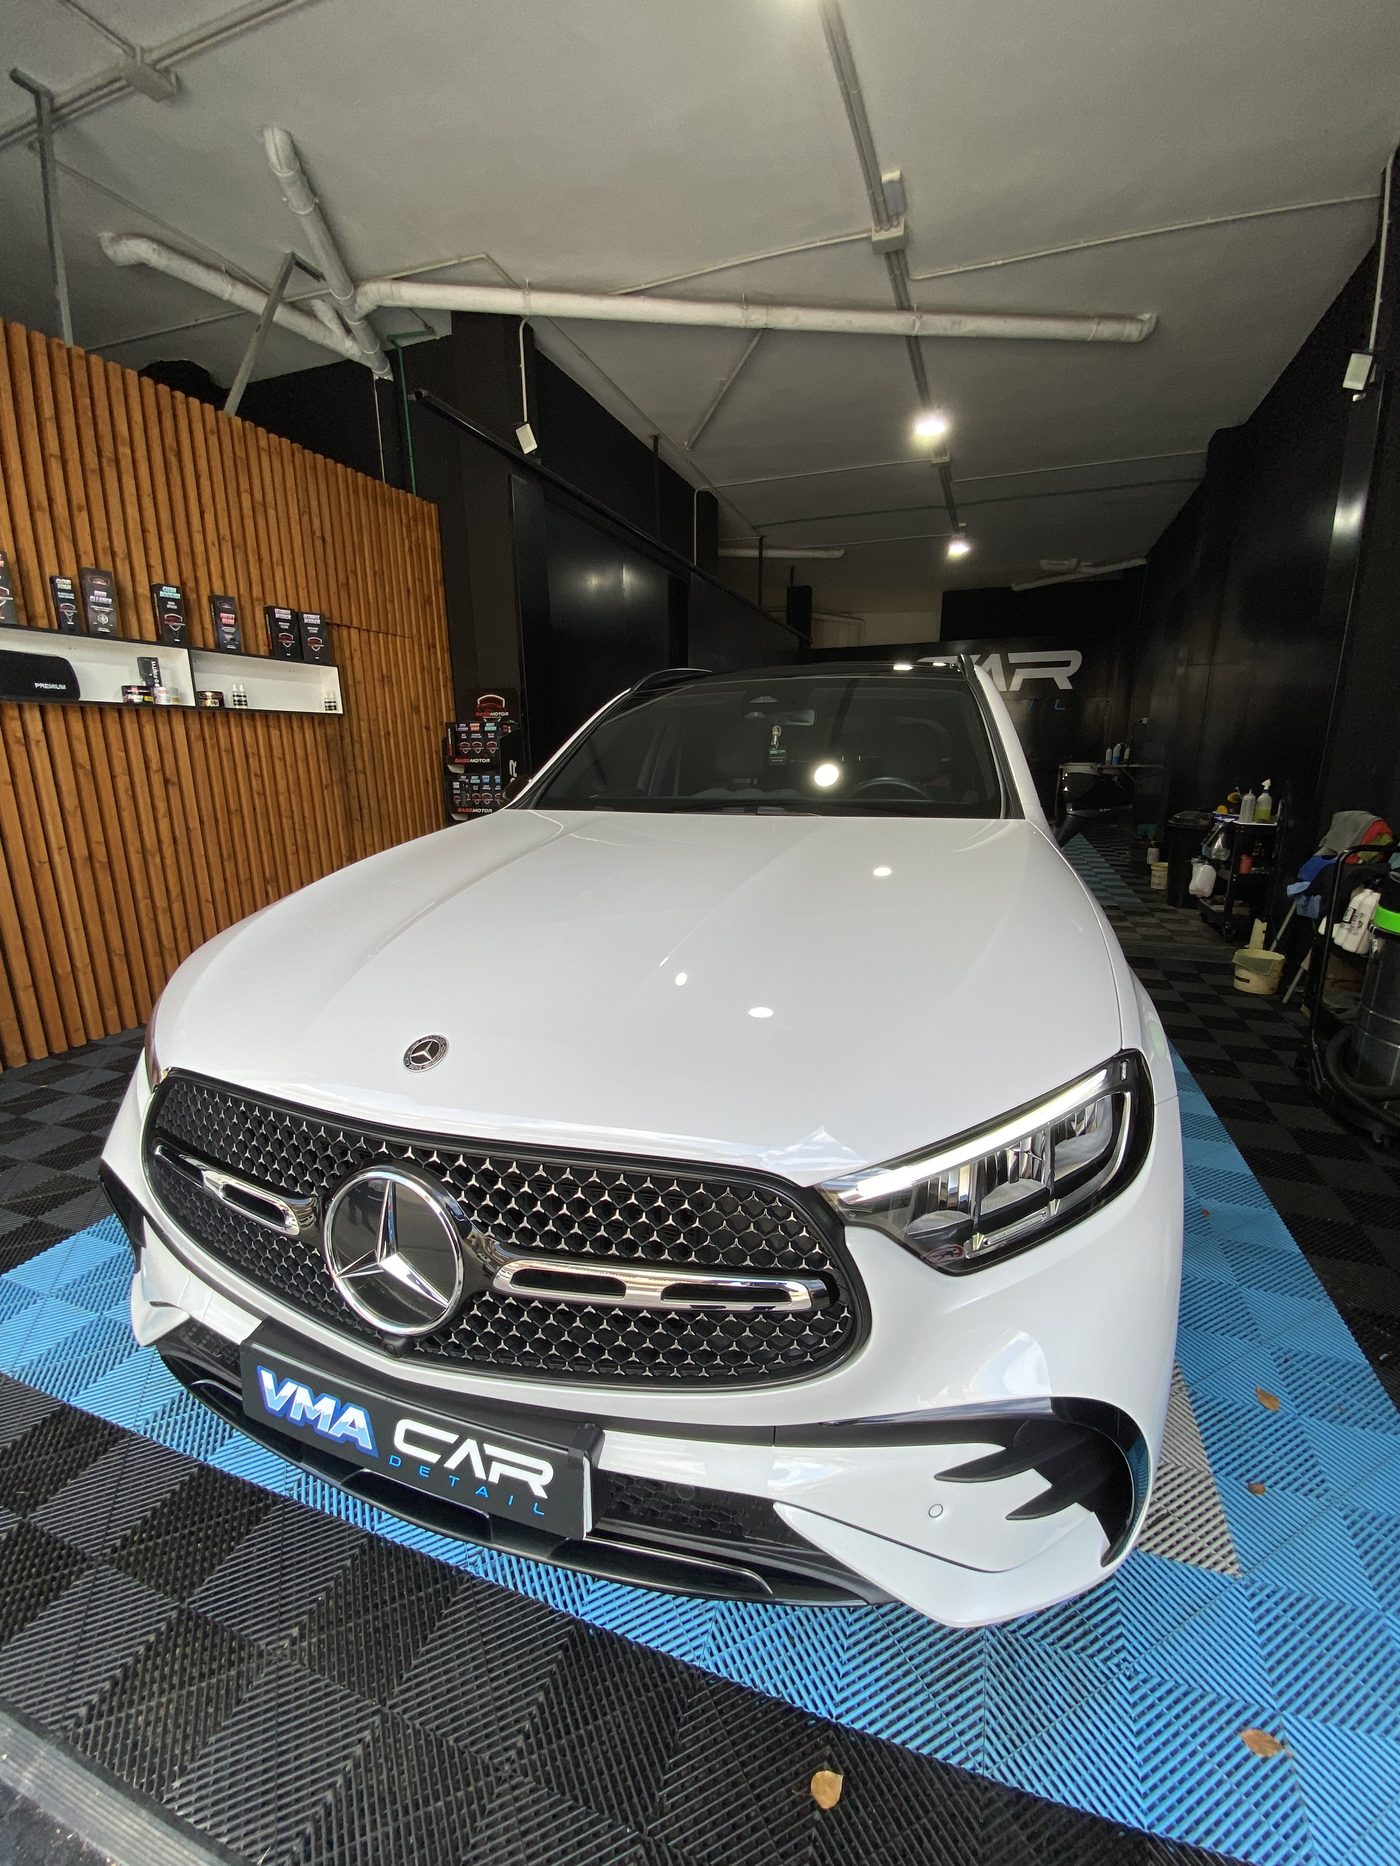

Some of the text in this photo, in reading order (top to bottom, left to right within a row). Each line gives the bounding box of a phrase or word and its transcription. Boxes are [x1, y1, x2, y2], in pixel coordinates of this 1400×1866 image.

[34, 682, 67, 690] PREMIUM
[917, 650, 1083, 691] AR
[257, 1366, 554, 1499] VMA CAR
[388, 1454, 545, 1516] DETAIL
